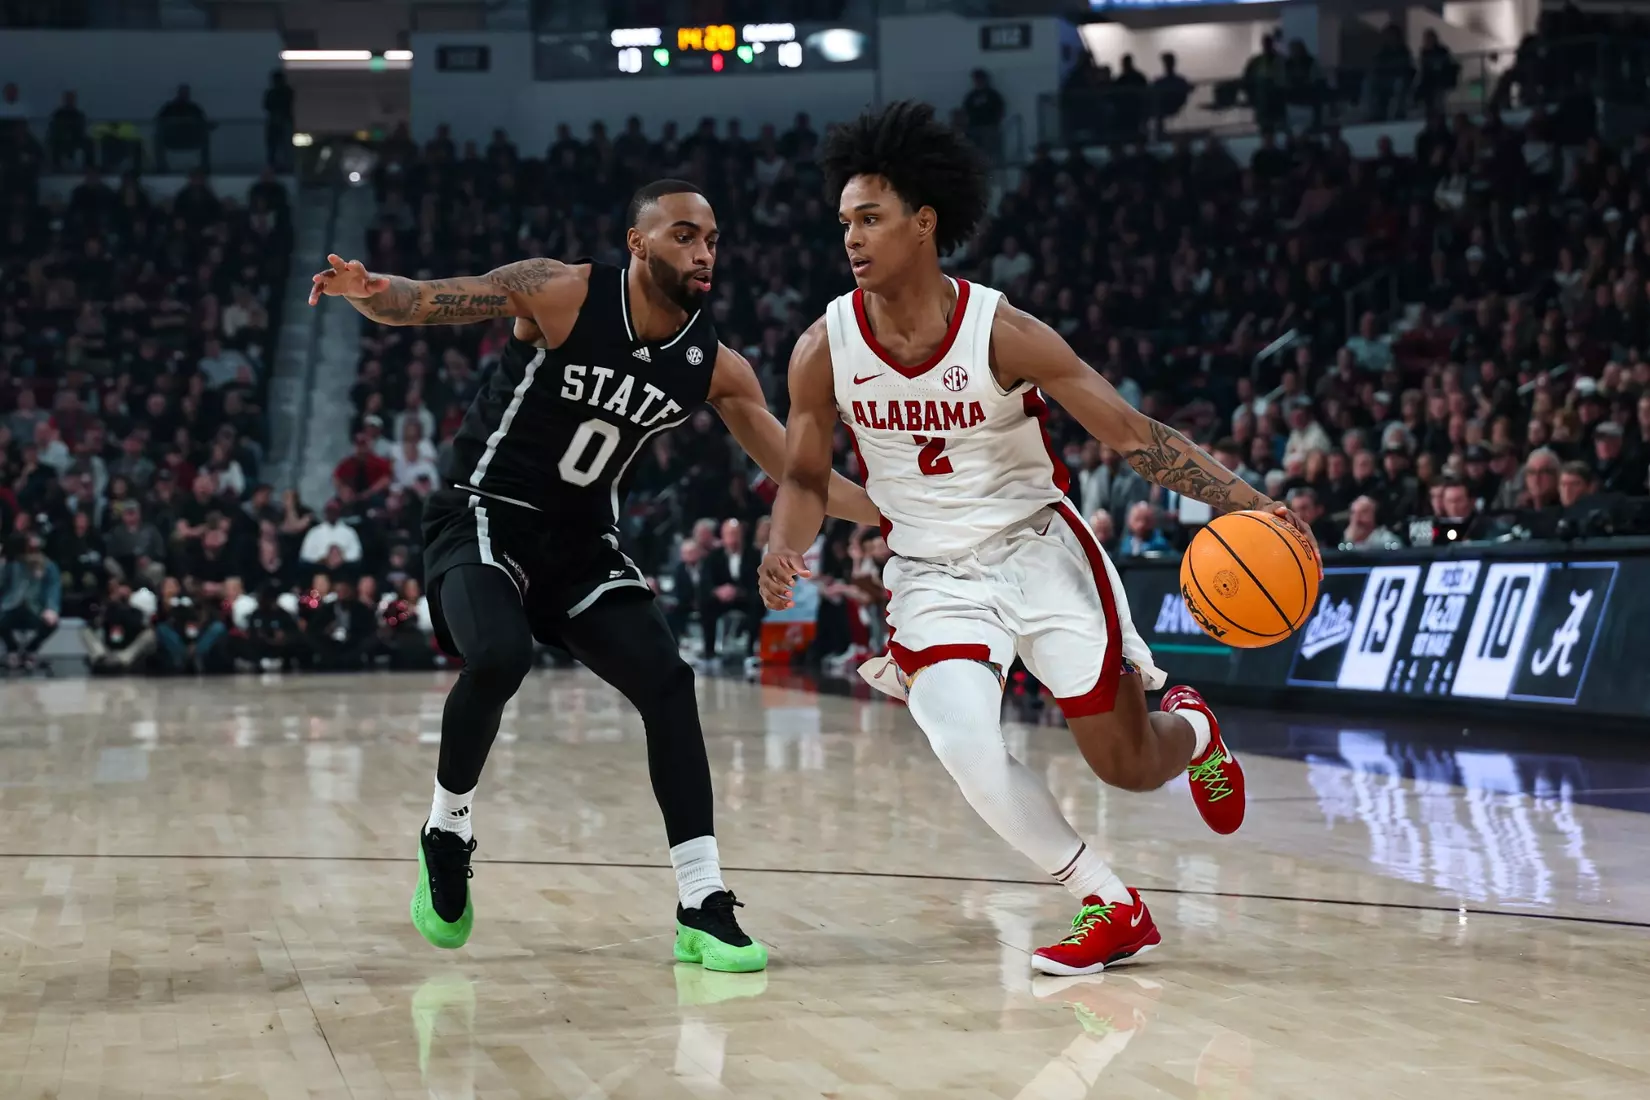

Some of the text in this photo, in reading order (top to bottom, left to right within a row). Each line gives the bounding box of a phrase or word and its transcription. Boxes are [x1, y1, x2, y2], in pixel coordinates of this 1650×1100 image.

[430, 293, 508, 307] SELF MADE
[632, 351, 652, 363] adidas
[687, 347, 703, 364] SEC
[944, 366, 968, 391] SEC
[851, 400, 987, 431] ALABAMA
[557, 418, 621, 488] 0
[911, 434, 955, 476] 2
[1359, 577, 1407, 654] 13
[1477, 575, 1531, 659] 10
